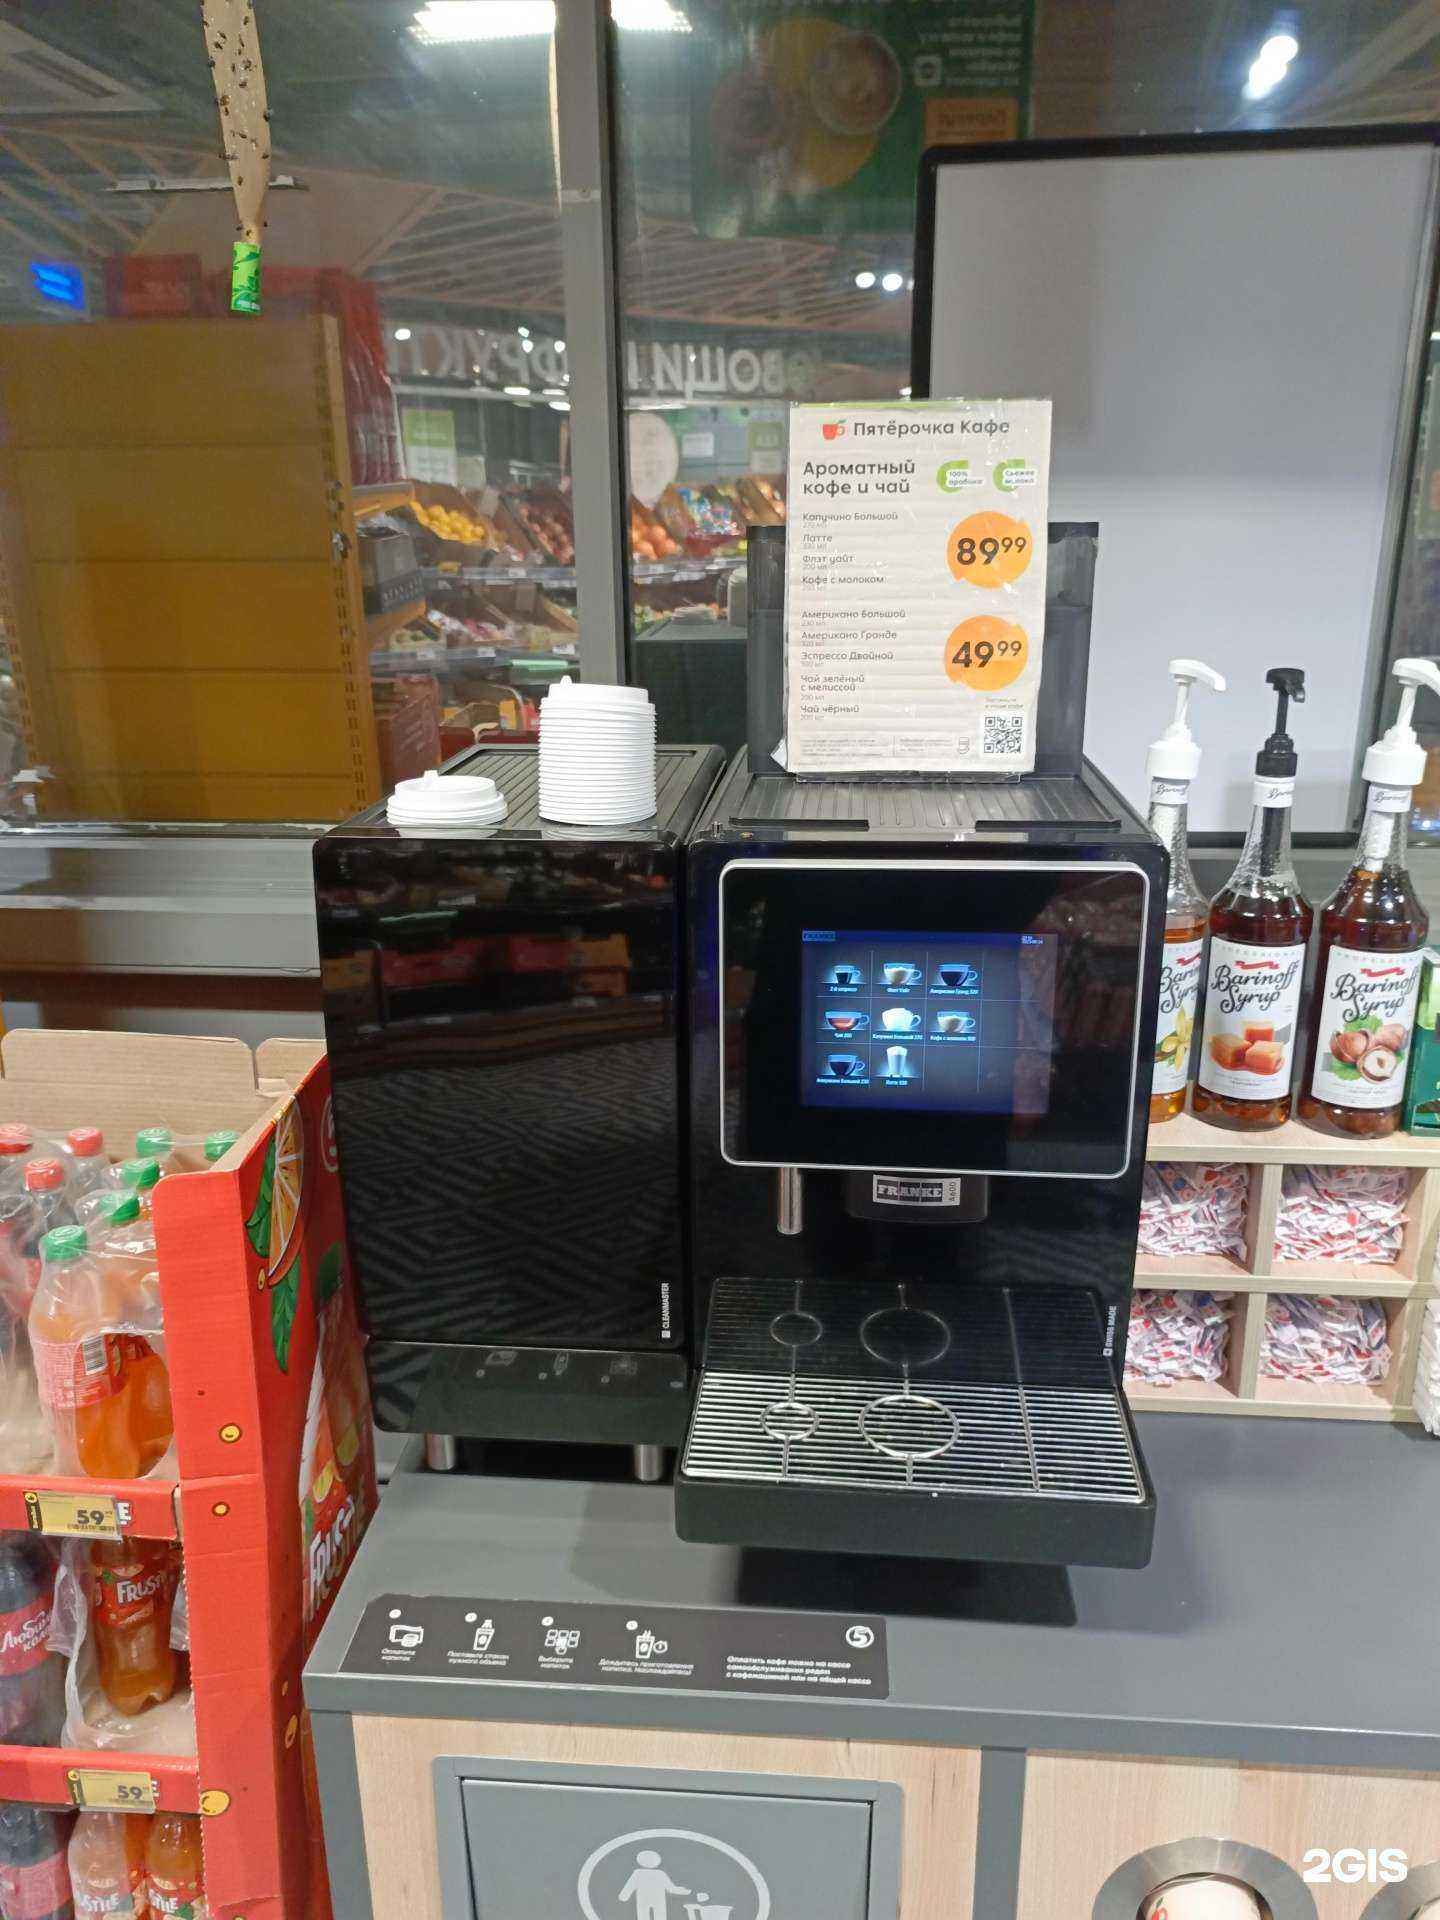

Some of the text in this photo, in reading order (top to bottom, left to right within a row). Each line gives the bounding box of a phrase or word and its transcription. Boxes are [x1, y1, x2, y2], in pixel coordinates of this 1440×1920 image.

[854, 419, 1010, 438] Пятёрочка Кафе
[803, 458, 915, 477] Ароматный
[803, 477, 910, 497] кофе и чай
[803, 511, 898, 522] Капучино Большой
[803, 534, 833, 543] Латте
[957, 537, 1000, 566] 89
[802, 575, 828, 585] Кофе
[838, 576, 884, 584] молоком
[802, 610, 858, 620] Американо
[802, 630, 897, 641] Американо Гранде
[802, 651, 894, 662] Эспрессо Двойной
[952, 640, 1022, 668] 49 99
[801, 674, 820, 683] Чай
[809, 683, 856, 692] мелиссой
[801, 705, 860, 714] Чай чёрный
[1210, 959, 1300, 993] Barinoff
[1330, 965, 1419, 1001] Barinoff
[1220, 984, 1281, 1014] Syrup
[1342, 993, 1406, 1023] Syrup
[878, 1184, 942, 1198] FRANKE
[661, 1283, 670, 1328] CLEANMASTER
[77, 1509, 105, 1525] 59
[117, 1785, 142, 1800] 59
